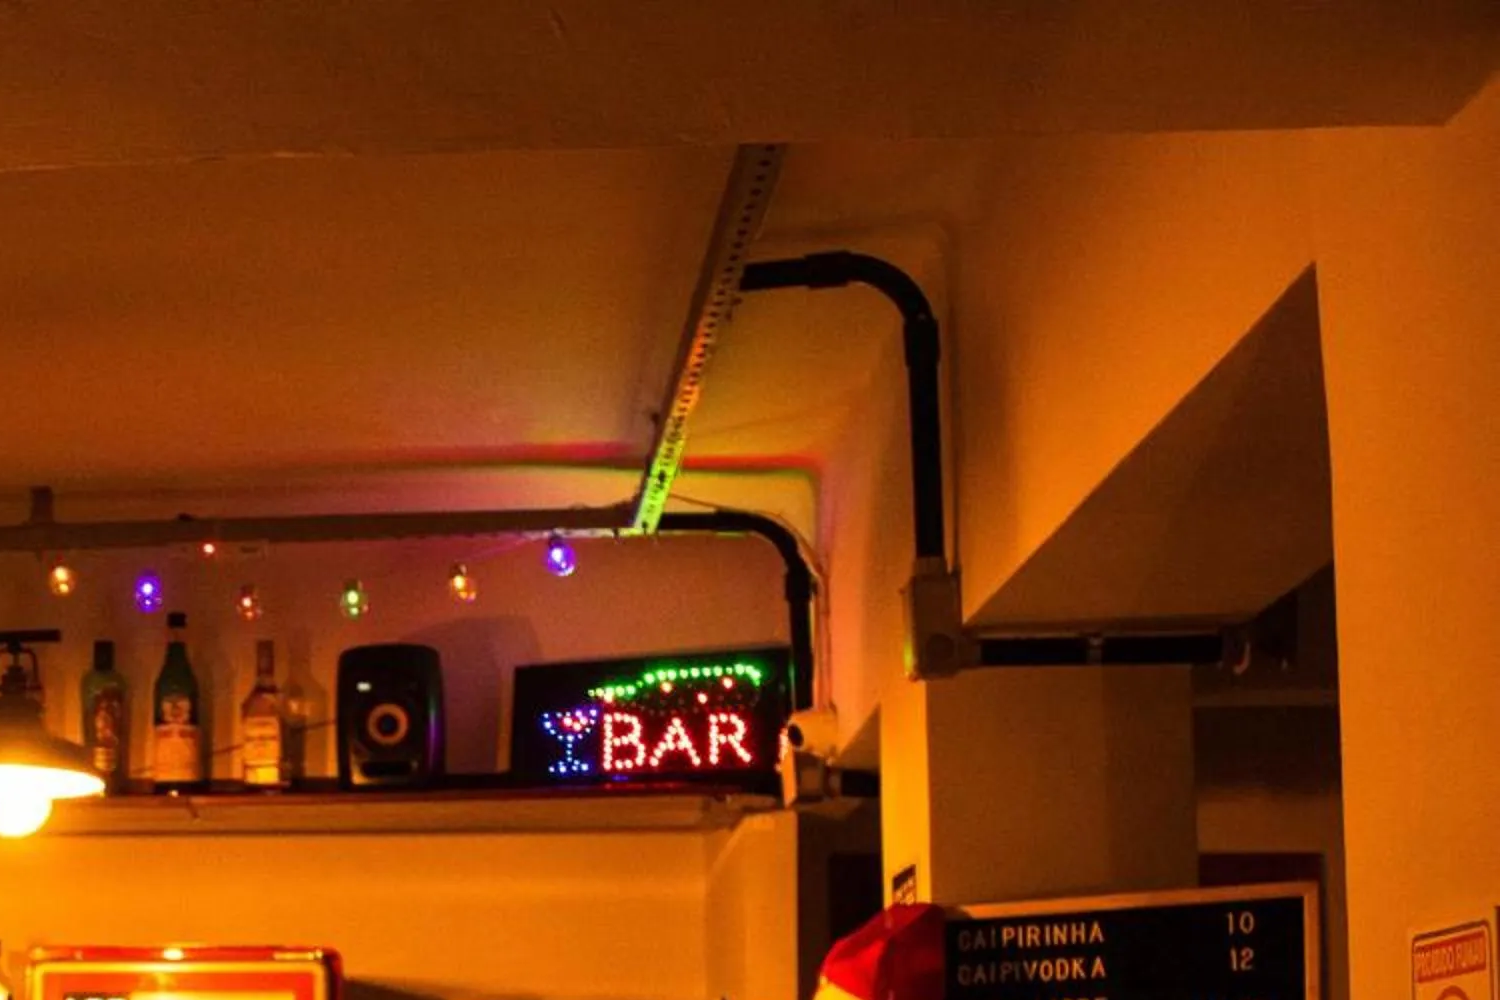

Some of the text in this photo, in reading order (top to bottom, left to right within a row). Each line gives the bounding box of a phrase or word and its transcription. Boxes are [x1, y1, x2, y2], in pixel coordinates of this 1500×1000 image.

[603, 711, 752, 771] BAR
[957, 911, 1255, 951] CAIPIRINHA 10
[957, 947, 1256, 986] CAIPIVODKA 12
